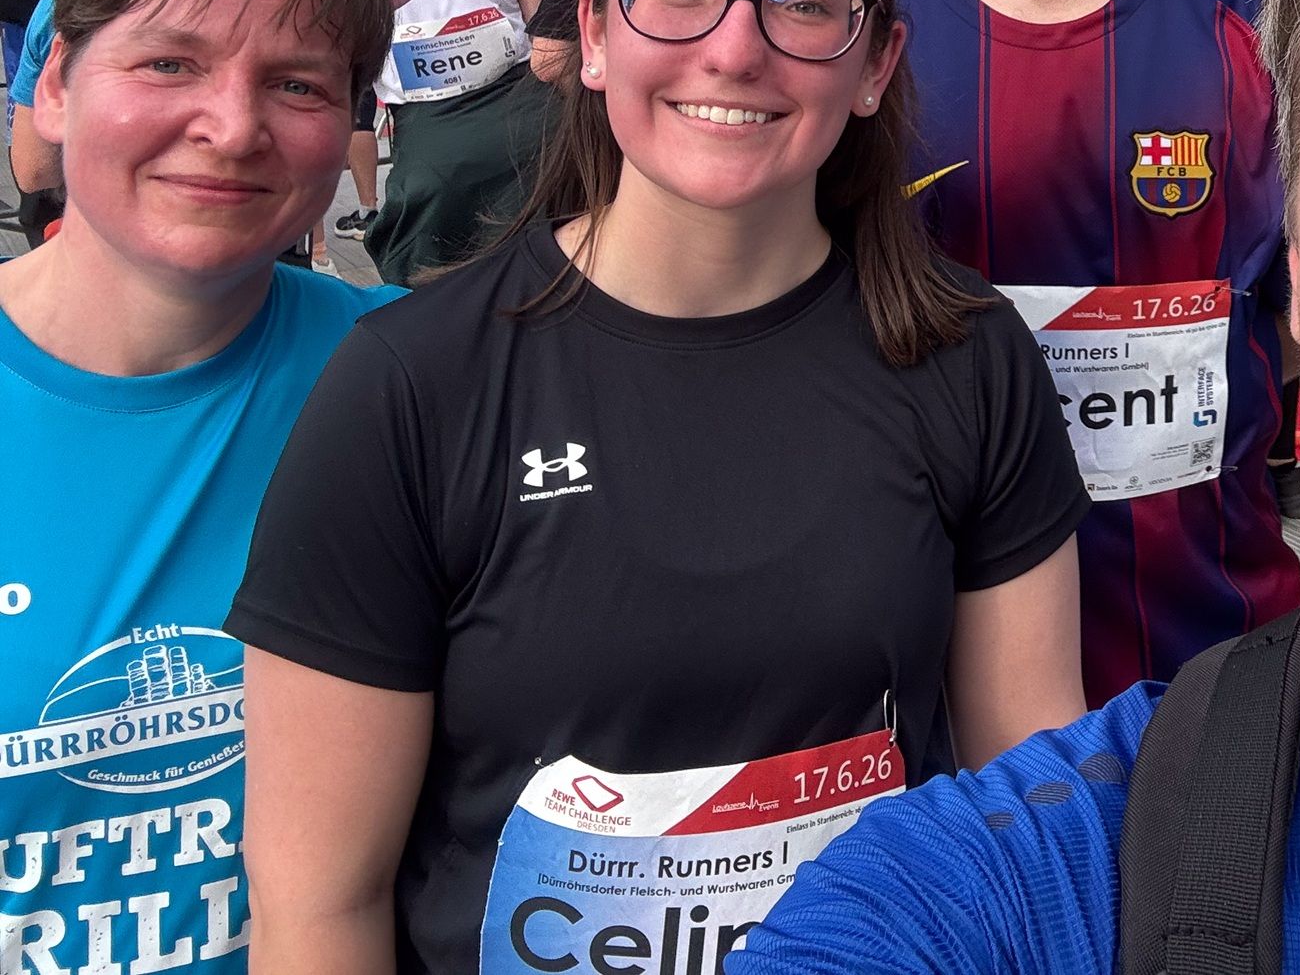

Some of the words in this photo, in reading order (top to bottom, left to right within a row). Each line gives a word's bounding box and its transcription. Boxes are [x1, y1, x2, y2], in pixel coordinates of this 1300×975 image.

[467, 9, 500, 26] 17.6.26
[410, 33, 475, 52] Rennschnecken
[413, 50, 483, 78] Rene
[443, 76, 463, 85] 4081
[1132, 294, 1216, 321] 17.6.26
[1041, 344, 1118, 361] Runners
[1055, 366, 1071, 374] und
[1073, 364, 1121, 374] Wurstwaren
[1197, 366, 1207, 407] INTERFACE
[1206, 371, 1214, 407] SYSTEMS
[520, 491, 554, 502] UNDER
[554, 484, 593, 497] ARMOUR
[132, 623, 181, 645] Echt
[0, 698, 245, 768] ÜRRRÖHRSD
[87, 770, 161, 783] Geschmack
[165, 765, 185, 779] für
[793, 749, 892, 805] 17.6.26
[551, 788, 576, 806] REWE
[544, 796, 567, 815] TEAM
[568, 807, 632, 826] CHALLENGE
[576, 820, 616, 834] DRESDEN
[786, 823, 809, 834] Einlass
[0, 798, 244, 893] UFTR
[568, 849, 646, 879] Dürrr.
[658, 849, 774, 879] Runners
[629, 885, 676, 897] Fleisch-
[680, 885, 704, 897] und
[707, 878, 775, 895] Wurstwaren
